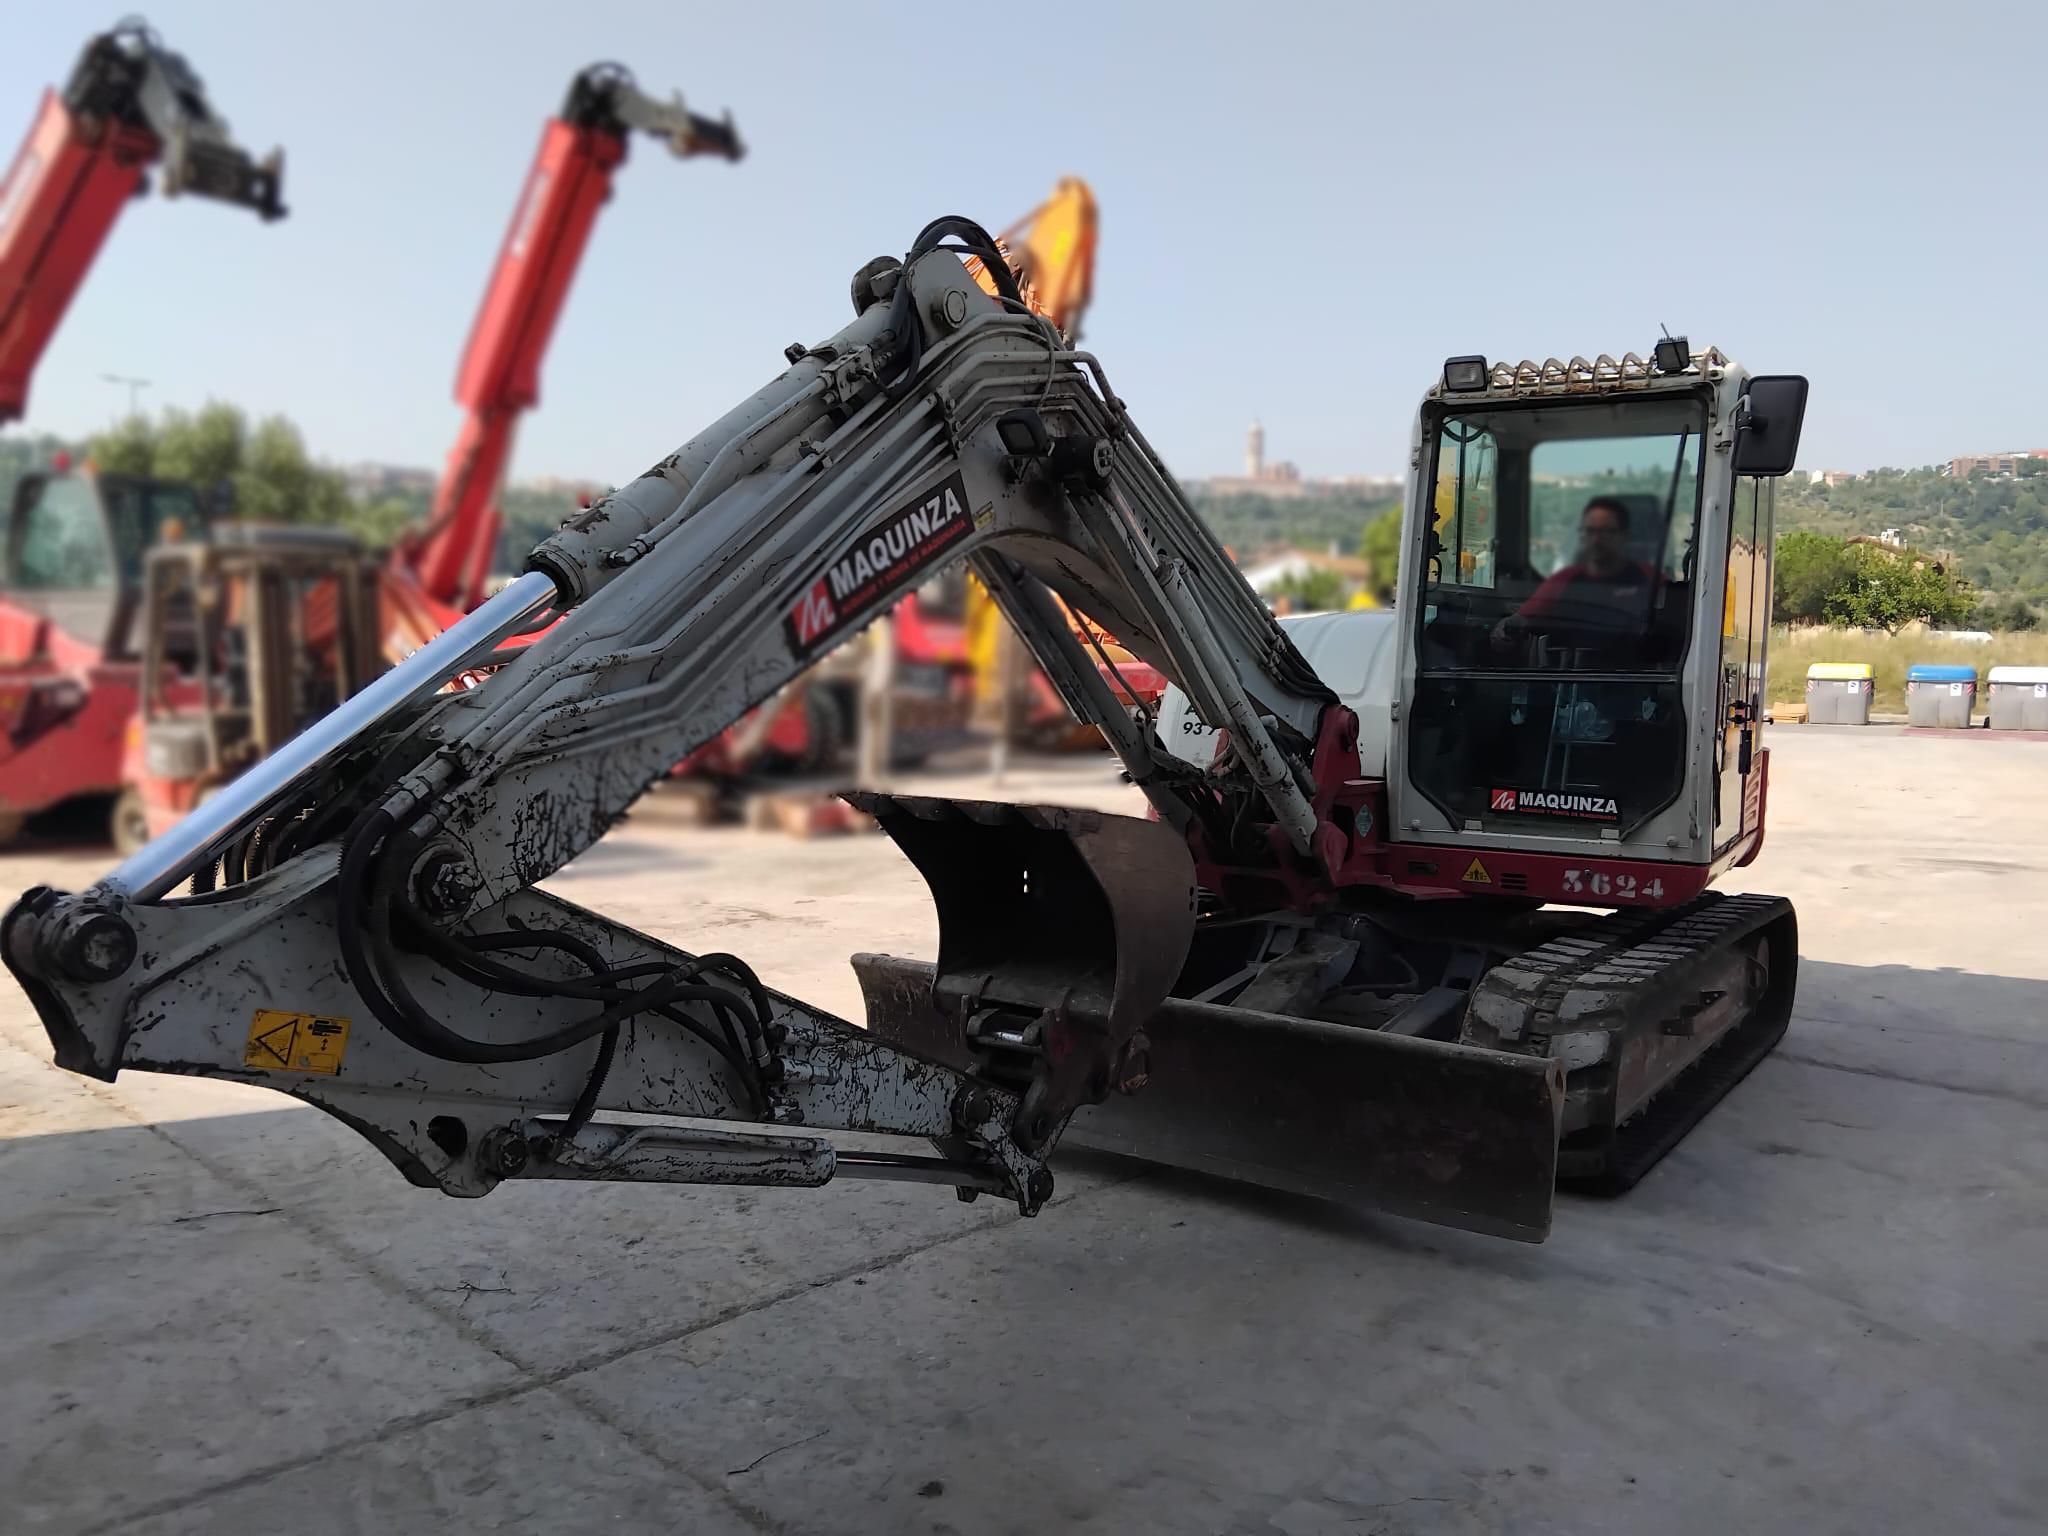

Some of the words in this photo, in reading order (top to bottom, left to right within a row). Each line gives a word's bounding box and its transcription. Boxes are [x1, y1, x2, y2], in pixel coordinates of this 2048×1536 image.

[829, 487, 962, 599] MAQUINZA
[1519, 791, 1618, 814] MAQUINZA
[1562, 869, 1664, 899] 3624
